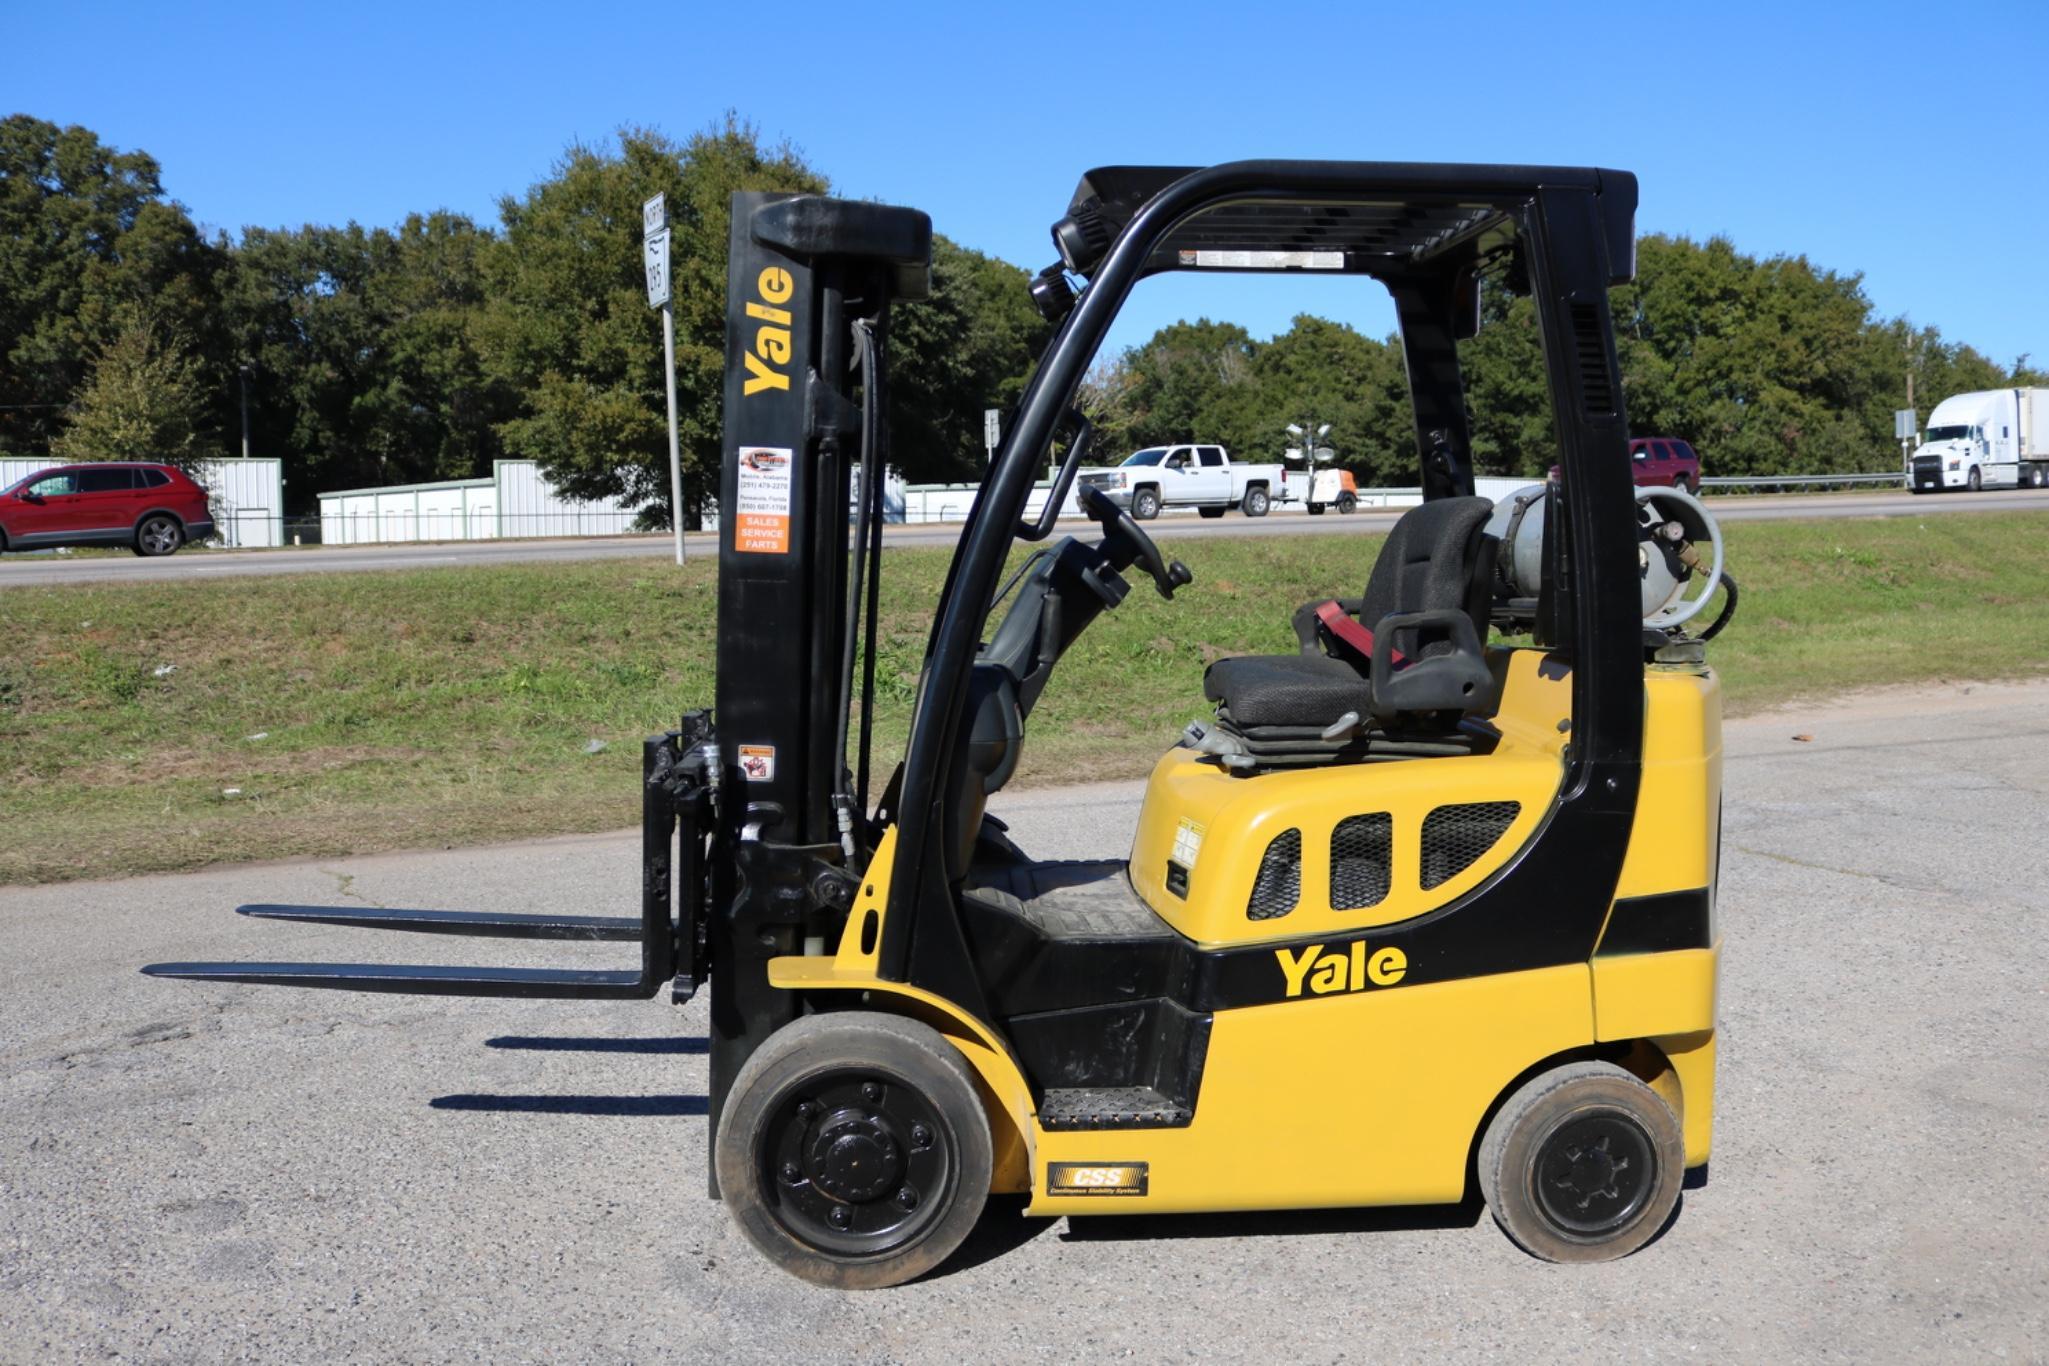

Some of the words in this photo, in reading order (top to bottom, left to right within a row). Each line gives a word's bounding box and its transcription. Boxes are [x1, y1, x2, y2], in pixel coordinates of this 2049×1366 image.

[744, 266, 793, 396] Yale
[746, 517, 778, 526] SALES
[742, 528, 784, 538] SERVICE
[746, 540, 778, 549] PARTS
[1274, 940, 1407, 997] Yale
[1074, 1168, 1121, 1185] CSS
